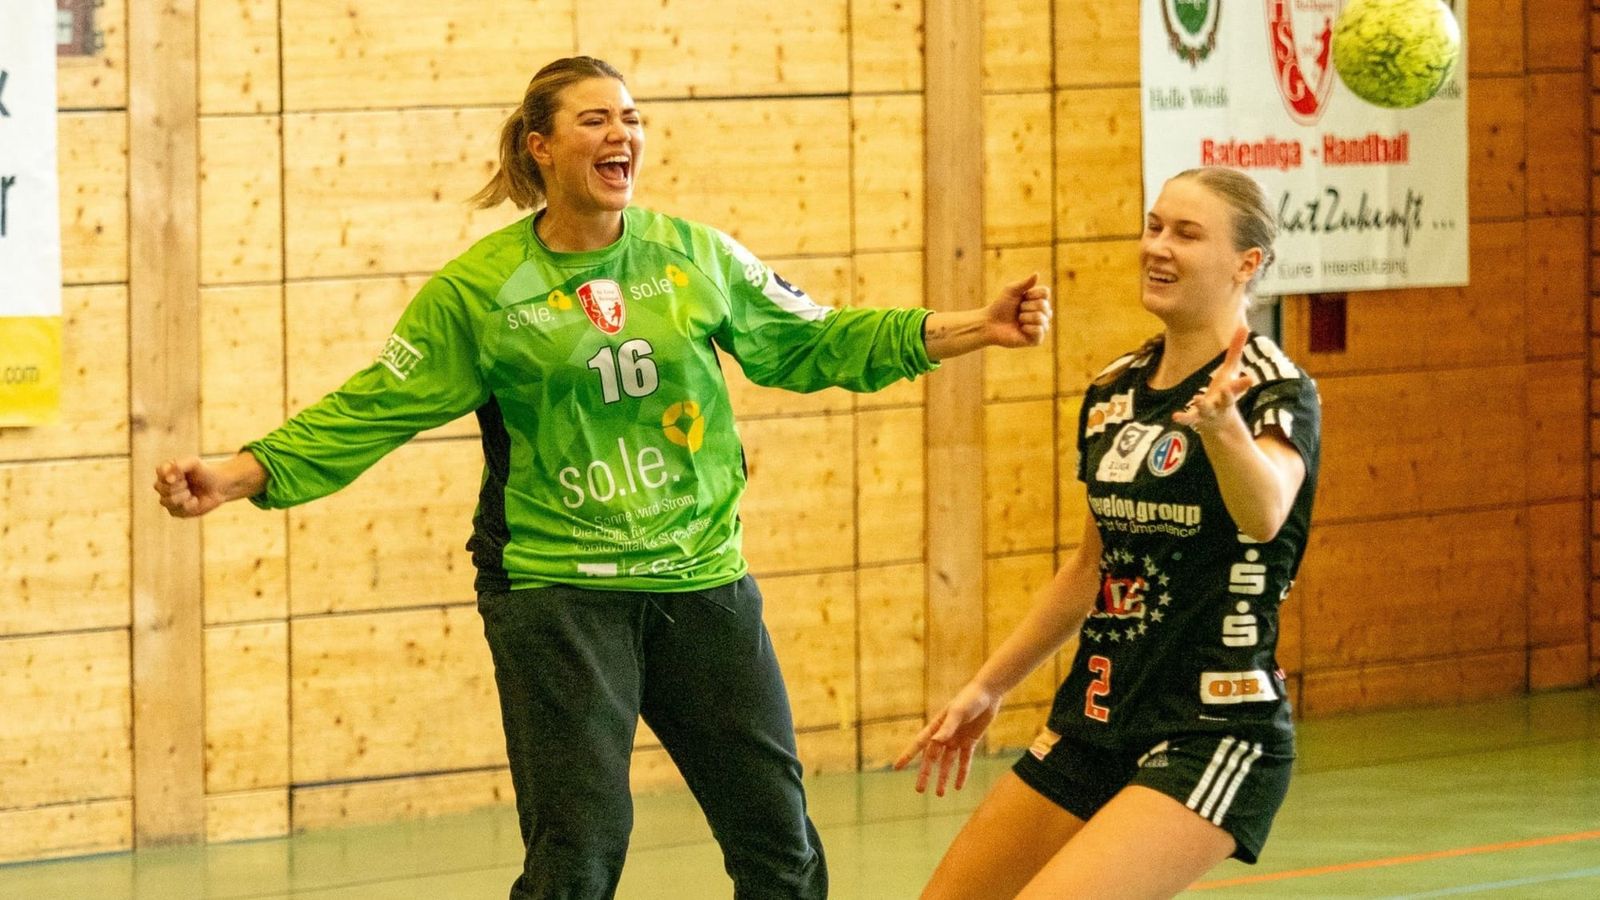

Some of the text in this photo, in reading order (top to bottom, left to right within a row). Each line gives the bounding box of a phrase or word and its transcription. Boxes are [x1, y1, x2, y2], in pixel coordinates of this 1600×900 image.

[1323, 132, 1409, 164] Handball
[507, 303, 556, 330] so.le.
[587, 338, 660, 405] 16
[559, 437, 680, 509] so.le.
[594, 512, 632, 527] Sonne
[635, 504, 660, 518] wird
[1136, 501, 1201, 526] group
[572, 526, 592, 537] Die
[631, 526, 647, 539] für
[1085, 655, 1110, 722] 2
